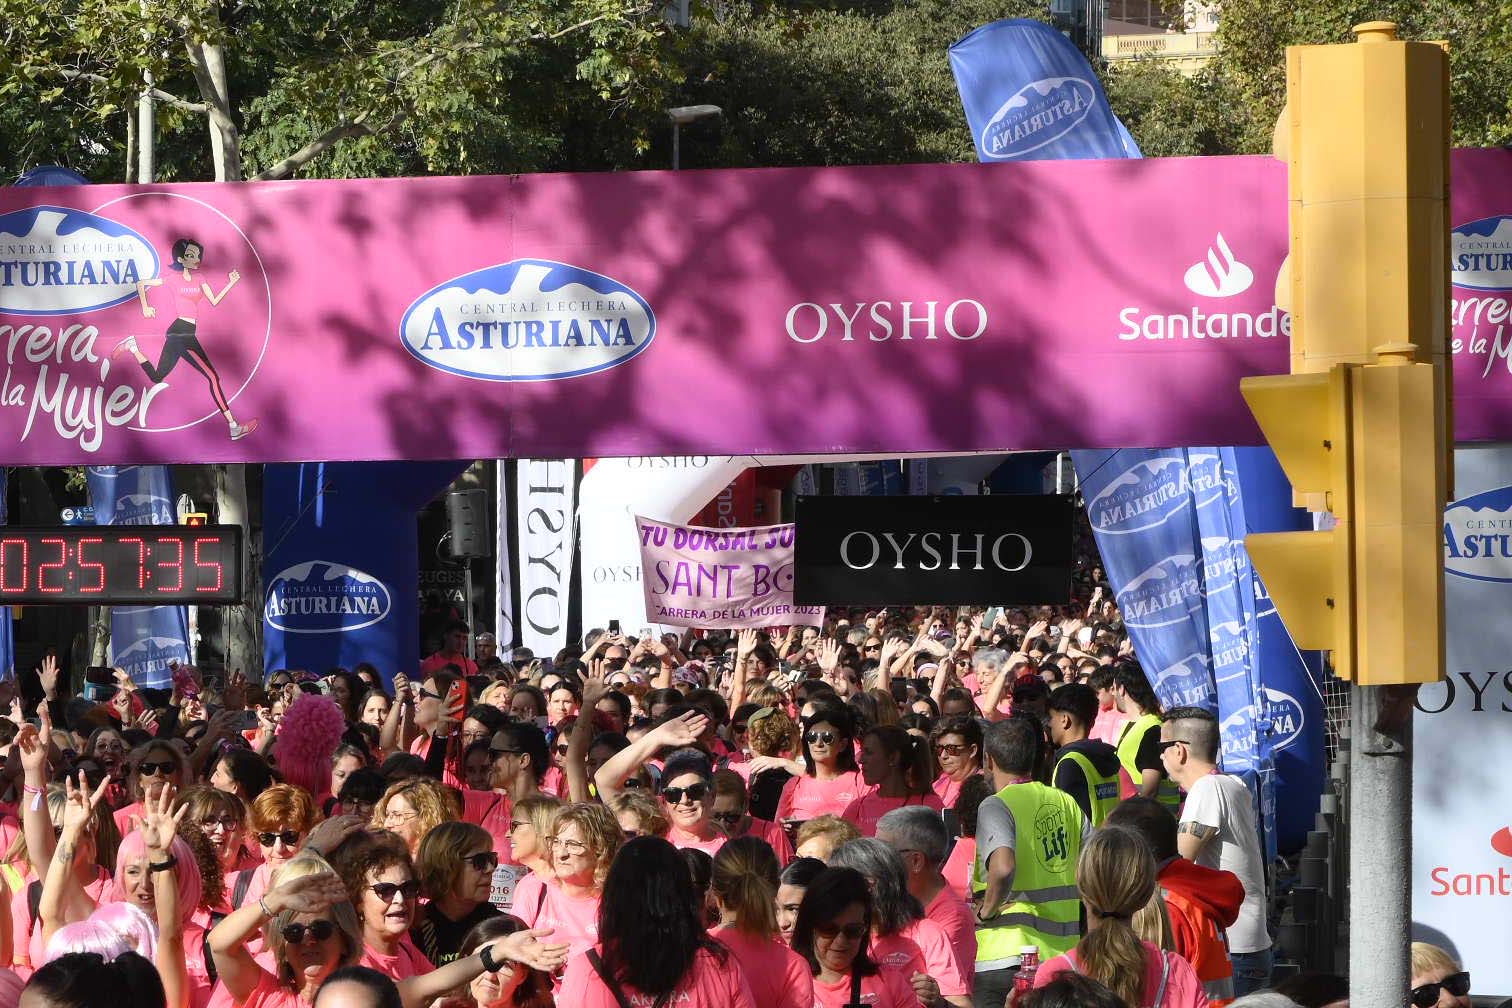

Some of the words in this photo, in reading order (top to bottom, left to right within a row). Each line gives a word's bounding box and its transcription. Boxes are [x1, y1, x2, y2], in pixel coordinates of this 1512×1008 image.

[63, 243, 136, 254] LECHERA
[459, 303, 538, 315] CENTRAL
[546, 300, 627, 312] LECHERA
[785, 299, 988, 344] OYSHO
[1119, 305, 1292, 342] Santande
[420, 306, 636, 351] ASTURIANA
[0, 369, 26, 407] la
[21, 358, 170, 452] Mujer
[526, 457, 566, 636] OYSH
[640, 524, 669, 548] TU
[673, 528, 758, 552] DORSAL
[764, 525, 795, 550] SU
[839, 531, 1034, 572] OYSHO
[0, 537, 222, 593] 02:57:35
[652, 560, 741, 599] SANT
[268, 590, 382, 618] ASTURIANA
[713, 608, 729, 620] DE
[732, 607, 746, 620] LA
[749, 603, 791, 618] MUJER
[793, 604, 821, 616] 2023
